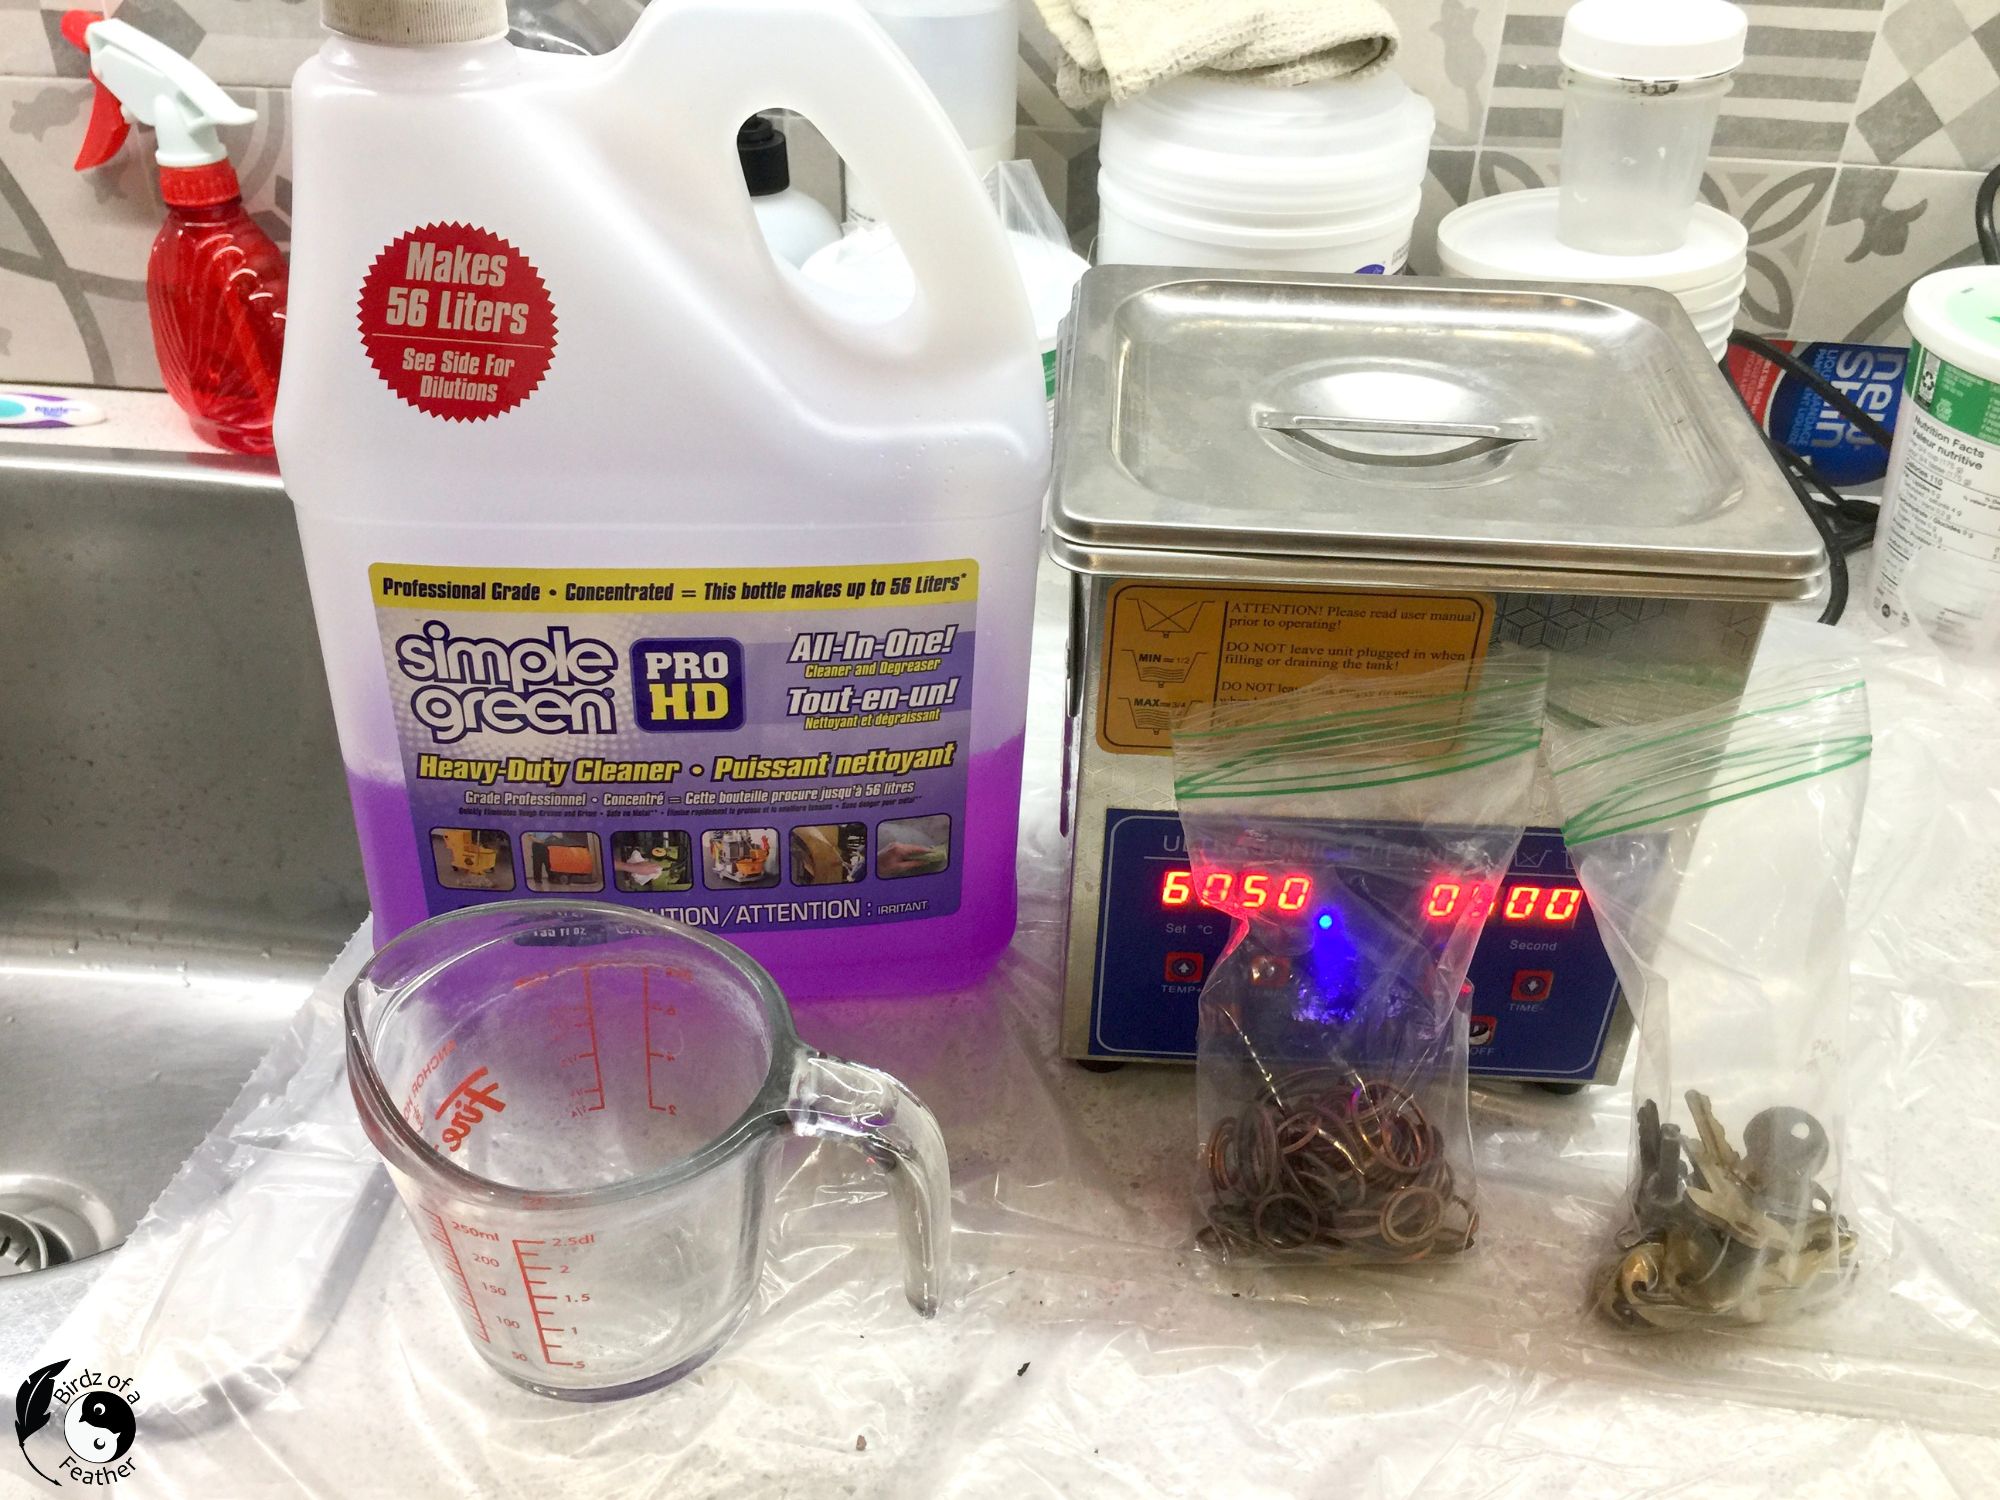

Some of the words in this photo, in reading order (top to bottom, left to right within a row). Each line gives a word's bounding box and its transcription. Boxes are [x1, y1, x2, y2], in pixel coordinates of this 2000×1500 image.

[405, 241, 508, 287] Makes
[386, 286, 429, 327] 56
[437, 290, 529, 335] Liters
[402, 347, 435, 371] See
[441, 350, 480, 376] Side
[484, 354, 515, 378] For
[420, 375, 498, 403] Dilutions
[1914, 415, 1950, 444] Nutrition
[1952, 438, 1985, 459] Facts
[1937, 446, 1983, 471] nutritive
[383, 577, 486, 600] Professional
[491, 582, 540, 600] Grade
[565, 582, 674, 601] Concentrated
[704, 582, 736, 601] This
[741, 581, 786, 600] bottle
[791, 580, 841, 599] makes
[846, 581, 865, 600] up
[870, 579, 885, 597] to
[890, 576, 911, 595] 56
[1231, 602, 1323, 616] ATTENTION!
[1327, 606, 1367, 618] Please
[1369, 608, 1397, 620] read
[1400, 610, 1427, 621] user
[1430, 611, 1476, 622] manual
[1228, 617, 1260, 629] prior
[1263, 618, 1276, 628] to
[1278, 619, 1342, 632] operating!
[786, 624, 959, 664] All-In-One!
[1225, 641, 1250, 653] DO
[1253, 642, 1287, 653] NOT
[1290, 644, 1325, 656] leave
[1328, 646, 1354, 657] unit
[1357, 648, 1410, 661] plugged
[1413, 649, 1427, 660] in
[1430, 650, 1466, 661] when
[395, 620, 619, 693] simple
[645, 651, 729, 680] PRO
[1138, 653, 1162, 663] MIN
[1225, 653, 1263, 668] filling
[1266, 657, 1281, 667] or
[1284, 656, 1339, 670] draining
[1343, 659, 1362, 670] the
[1366, 660, 1399, 672] tank!
[804, 663, 852, 679] Cleaner
[855, 661, 876, 677] and
[879, 658, 942, 676] Degreaser
[787, 677, 961, 717] Tout-en-un!
[1221, 681, 1242, 692] DO
[1246, 681, 1276, 693] NOT
[650, 683, 729, 720] HD
[1134, 698, 1160, 707] MAX
[411, 685, 617, 744] green
[804, 715, 858, 731] Nettoyant
[861, 714, 873, 727] et
[875, 709, 941, 728] dégraissant
[417, 753, 571, 787] Heavy-Duty
[573, 757, 682, 784] Cleaner
[710, 752, 831, 783] Puissant
[832, 740, 957, 777] nettoyant
[465, 791, 500, 805] Grade
[504, 792, 587, 807] Professionnel
[603, 791, 664, 807] Concentré
[685, 791, 716, 806] Cette
[719, 788, 768, 805] bouteille
[770, 787, 818, 805] procure
[865, 783, 881, 797] 56
[883, 781, 915, 797] litres
[649, 898, 860, 928] UTION/ATTENTION
[877, 900, 929, 916] IRRITANT
[1165, 923, 1187, 935] Set
[1509, 938, 1558, 952] Second
[451, 1220, 500, 1241] 250ml
[552, 1233, 595, 1248] 2.5dl
[472, 1252, 500, 1268] 200
[559, 1265, 570, 1274] 2
[482, 1281, 507, 1296] 150
[565, 1293, 591, 1303] 1.5
[496, 1315, 521, 1329] 100
[571, 1326, 578, 1335] 1
